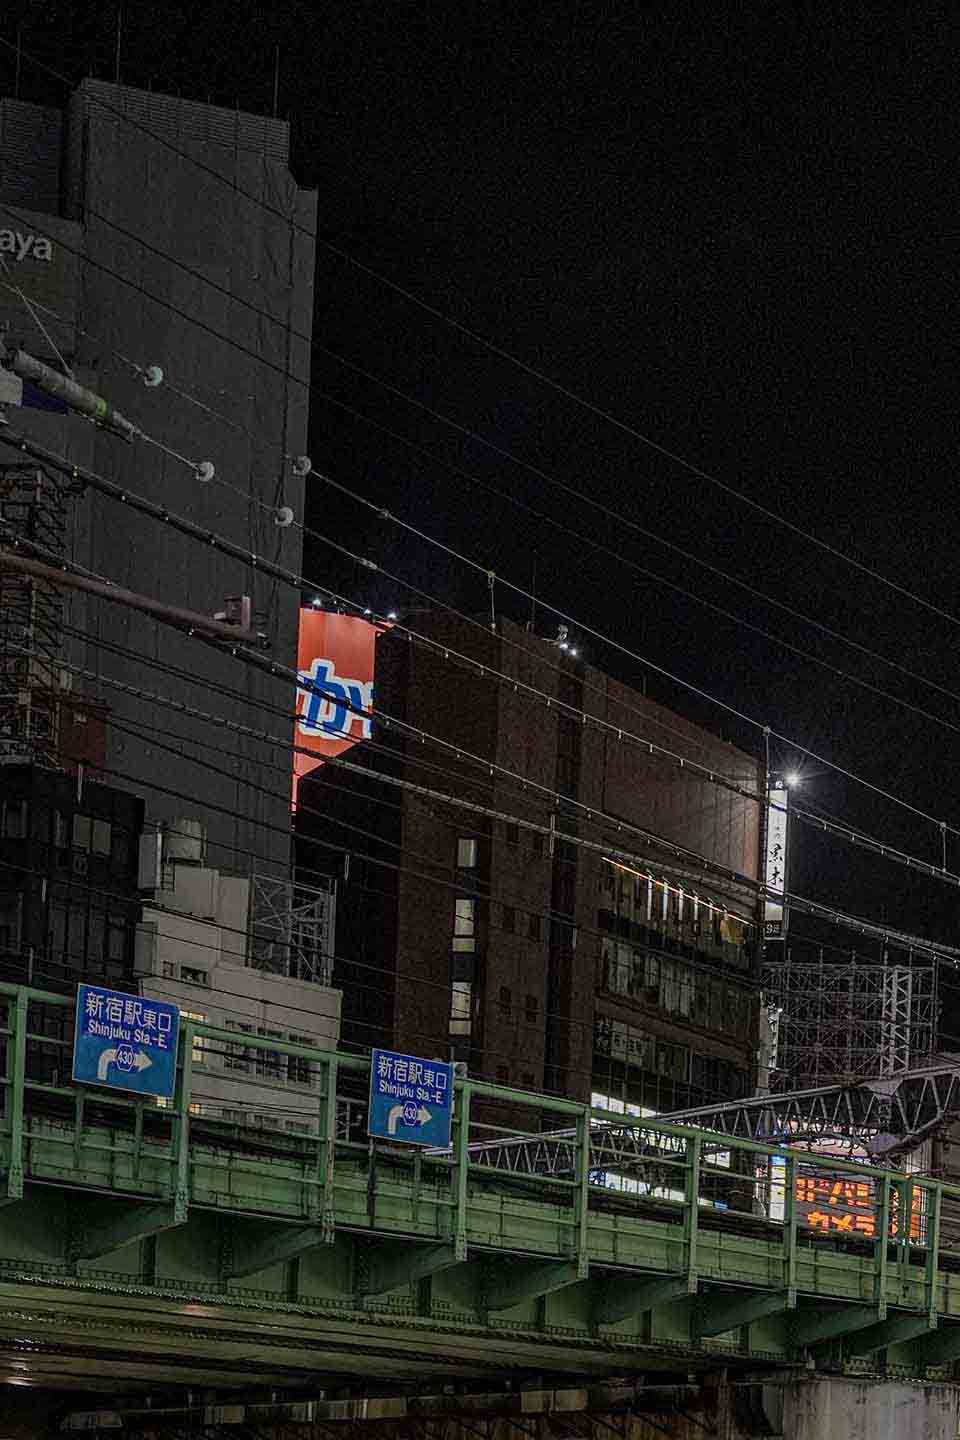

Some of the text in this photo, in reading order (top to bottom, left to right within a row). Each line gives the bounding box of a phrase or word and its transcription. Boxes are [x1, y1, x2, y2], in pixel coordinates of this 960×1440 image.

[86, 991, 172, 1033] 新宿駅東口
[88, 1019, 131, 1041] Shinjuku
[118, 1050, 133, 1066] 430
[377, 1055, 447, 1090] 新宿駅東口
[379, 1079, 414, 1098] Shinjuku
[807, 1211, 876, 1236] カメラ
